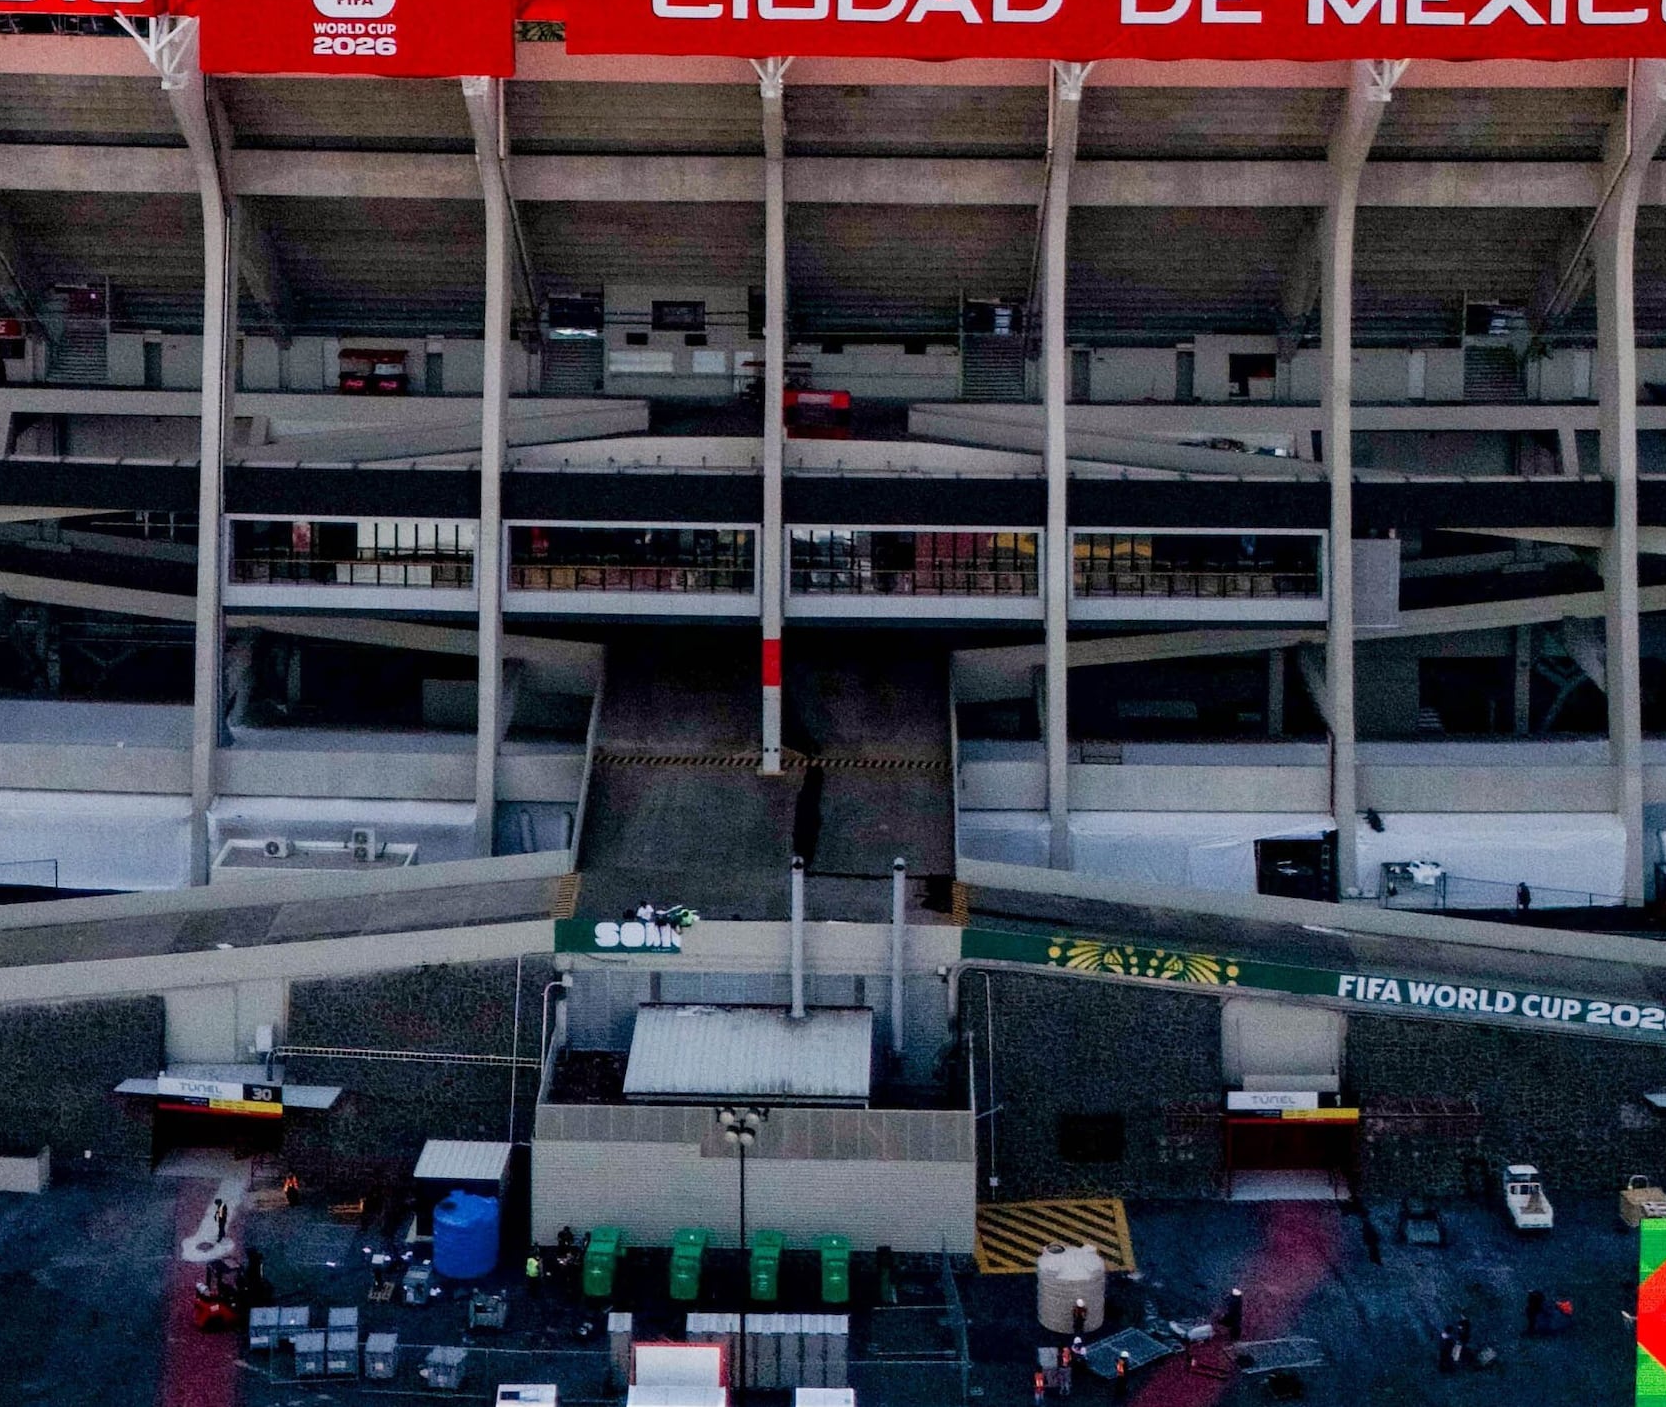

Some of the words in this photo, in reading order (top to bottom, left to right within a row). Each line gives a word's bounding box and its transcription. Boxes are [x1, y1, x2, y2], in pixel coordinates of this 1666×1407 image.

[313, 23, 366, 35] WORLD
[367, 23, 397, 35] CUP
[313, 37, 397, 56] 2026
[1337, 975, 1401, 1003] FIFA
[1407, 980, 1516, 1014] WORLD
[1522, 994, 1582, 1021] CUP
[252, 1088, 272, 1102] 30
[1334, 1094, 1341, 1106] 1
